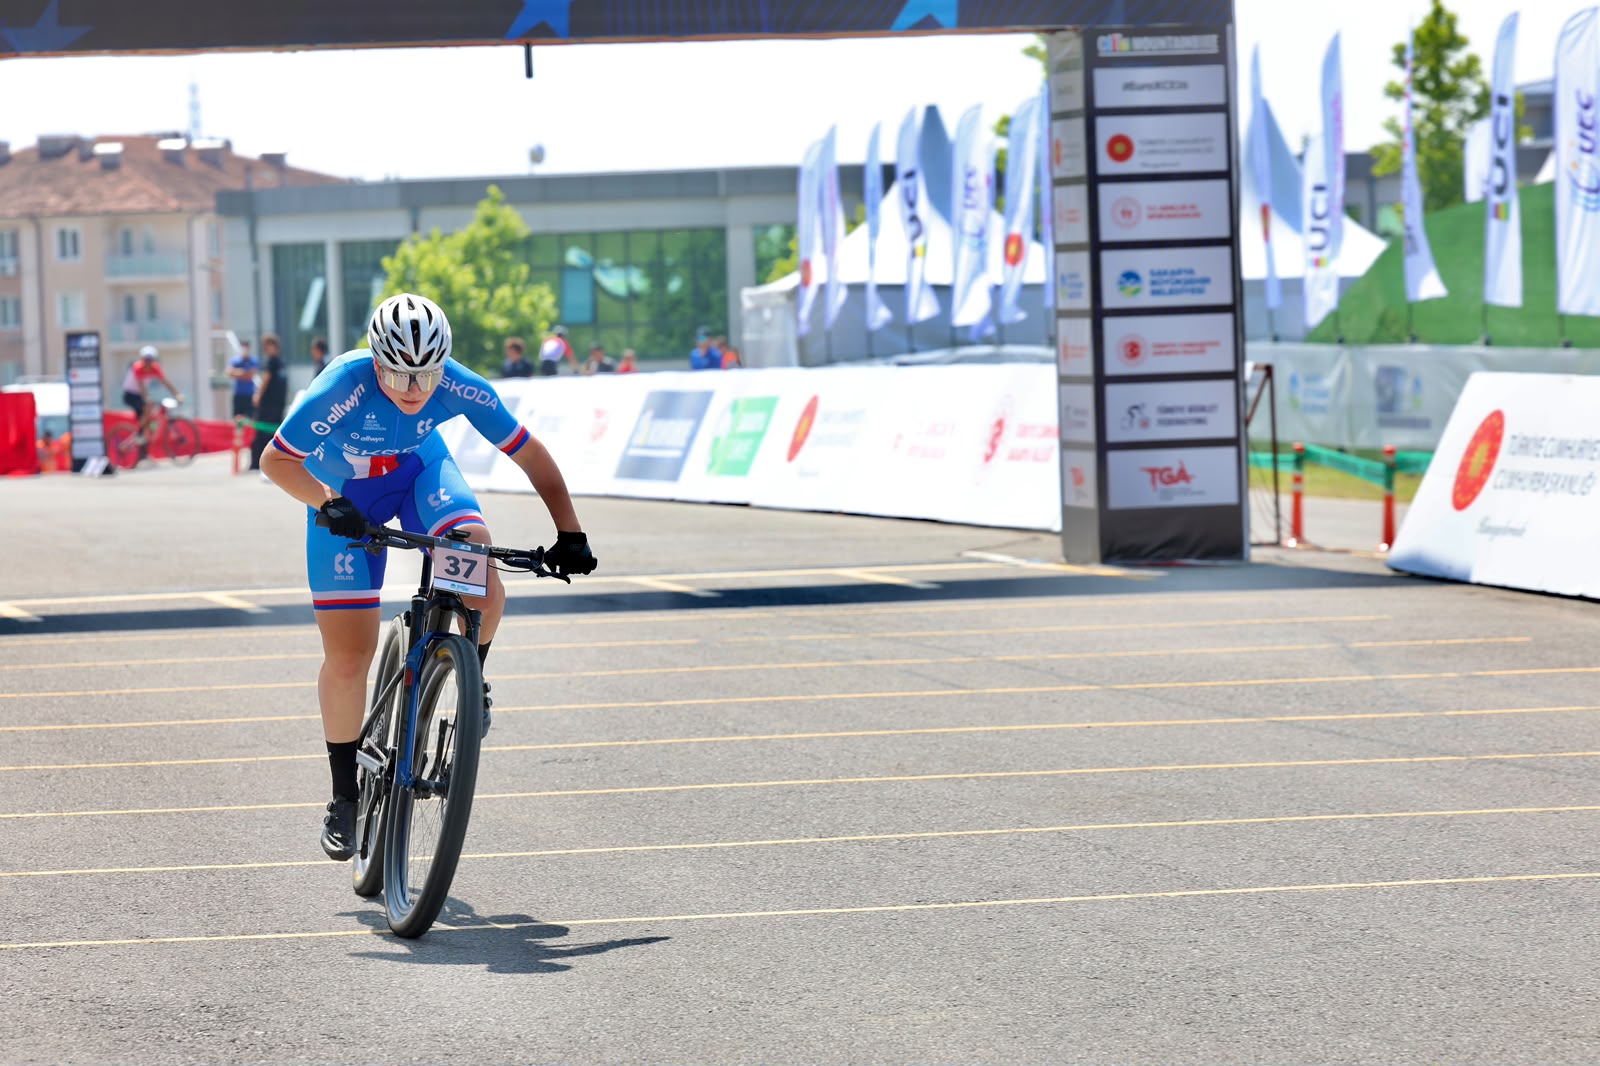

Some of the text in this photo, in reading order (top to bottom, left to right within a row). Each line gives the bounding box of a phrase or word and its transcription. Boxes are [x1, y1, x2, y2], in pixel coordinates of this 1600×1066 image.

[1494, 95, 1509, 196] UCI
[1309, 184, 1330, 251] UCI
[327, 383, 366, 424] allwyn
[360, 434, 385, 443] allwyn
[1139, 459, 1197, 492] TGA
[444, 555, 478, 579] 37
